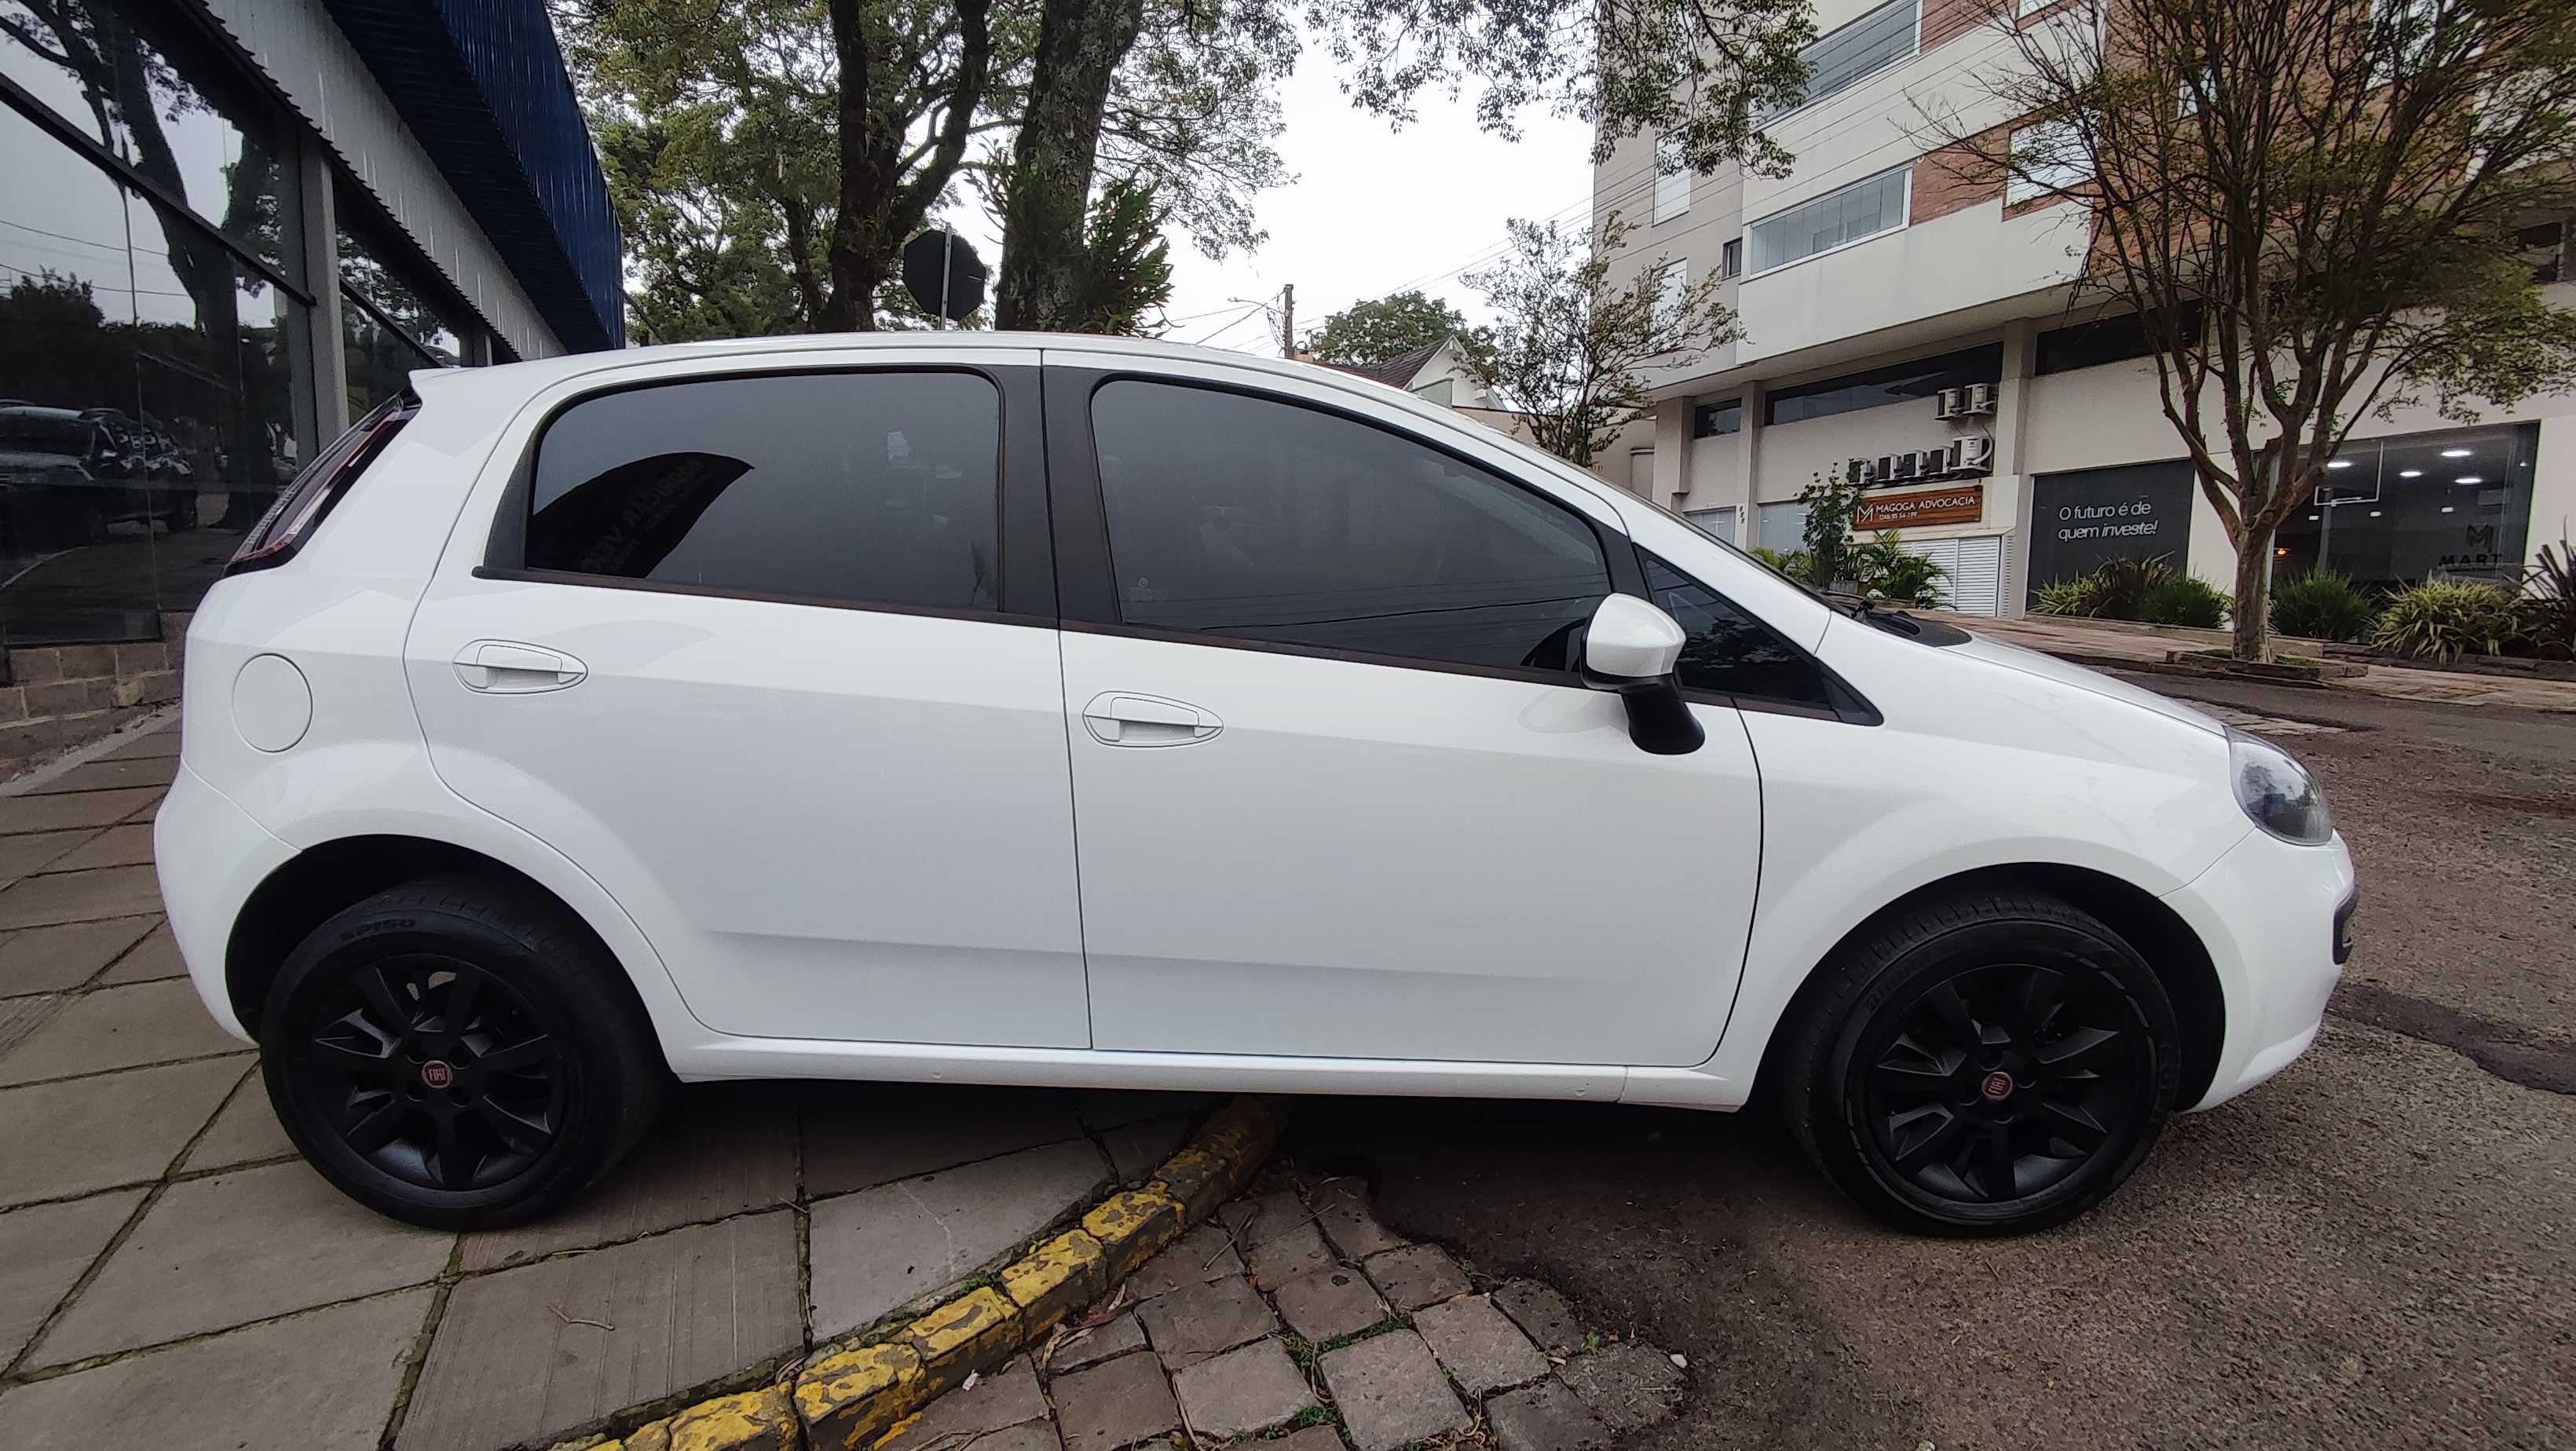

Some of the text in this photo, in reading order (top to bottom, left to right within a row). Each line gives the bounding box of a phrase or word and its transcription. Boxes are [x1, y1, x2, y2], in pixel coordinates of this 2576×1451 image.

[1876, 496, 1975, 513] MAGOGA ADVOCACIA
[2059, 501, 2152, 521] O futuro é de
[2058, 520, 2158, 543] quem investe!
[2439, 553, 2502, 566] MART
[428, 1068, 446, 1081] FIAT
[1988, 1077, 2007, 1095] FIAT
